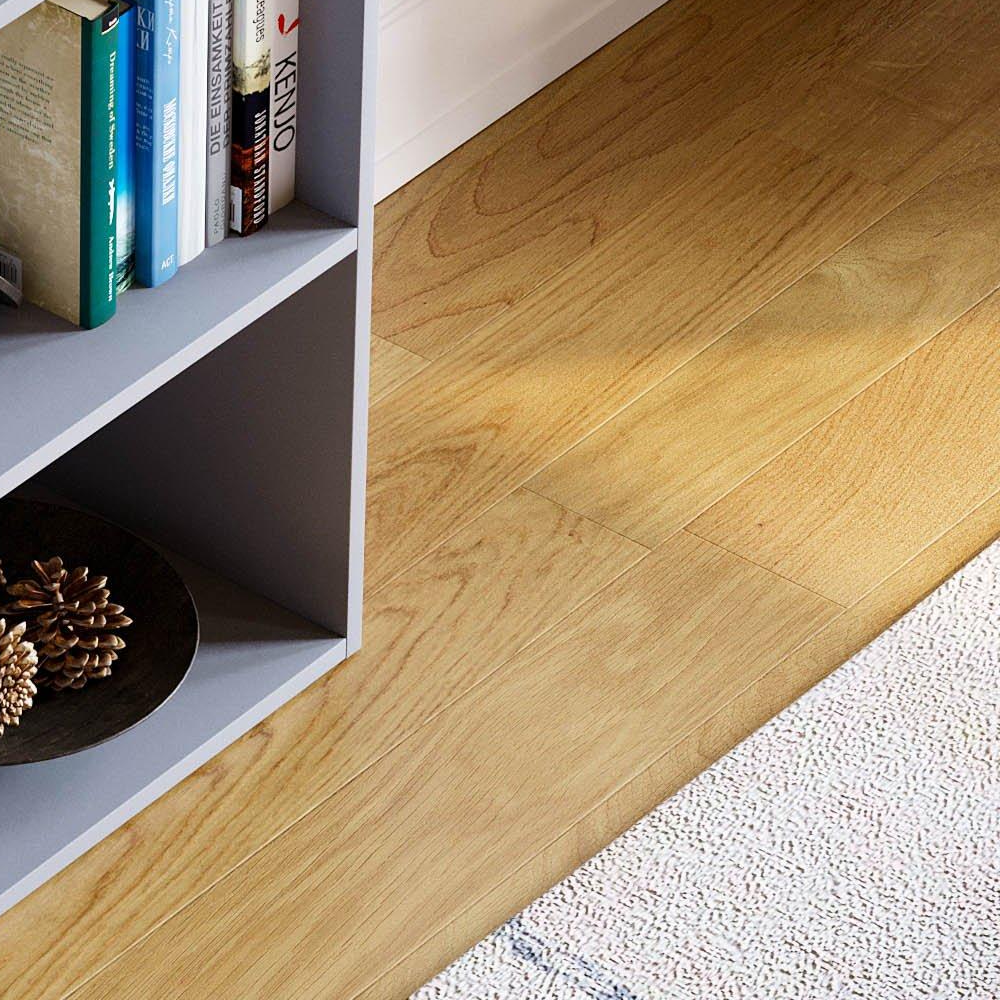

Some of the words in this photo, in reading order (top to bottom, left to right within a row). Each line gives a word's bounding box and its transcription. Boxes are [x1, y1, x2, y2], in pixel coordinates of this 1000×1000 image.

[108, 51, 117, 110] Dreaming
[211, 2, 223, 119] EINSAMKEIT
[109, 111, 116, 122] of
[273, 51, 297, 152] KENJO
[108, 123, 116, 170] Sweden
[210, 122, 221, 156] DIE
[254, 109, 267, 164] JONATHAN
